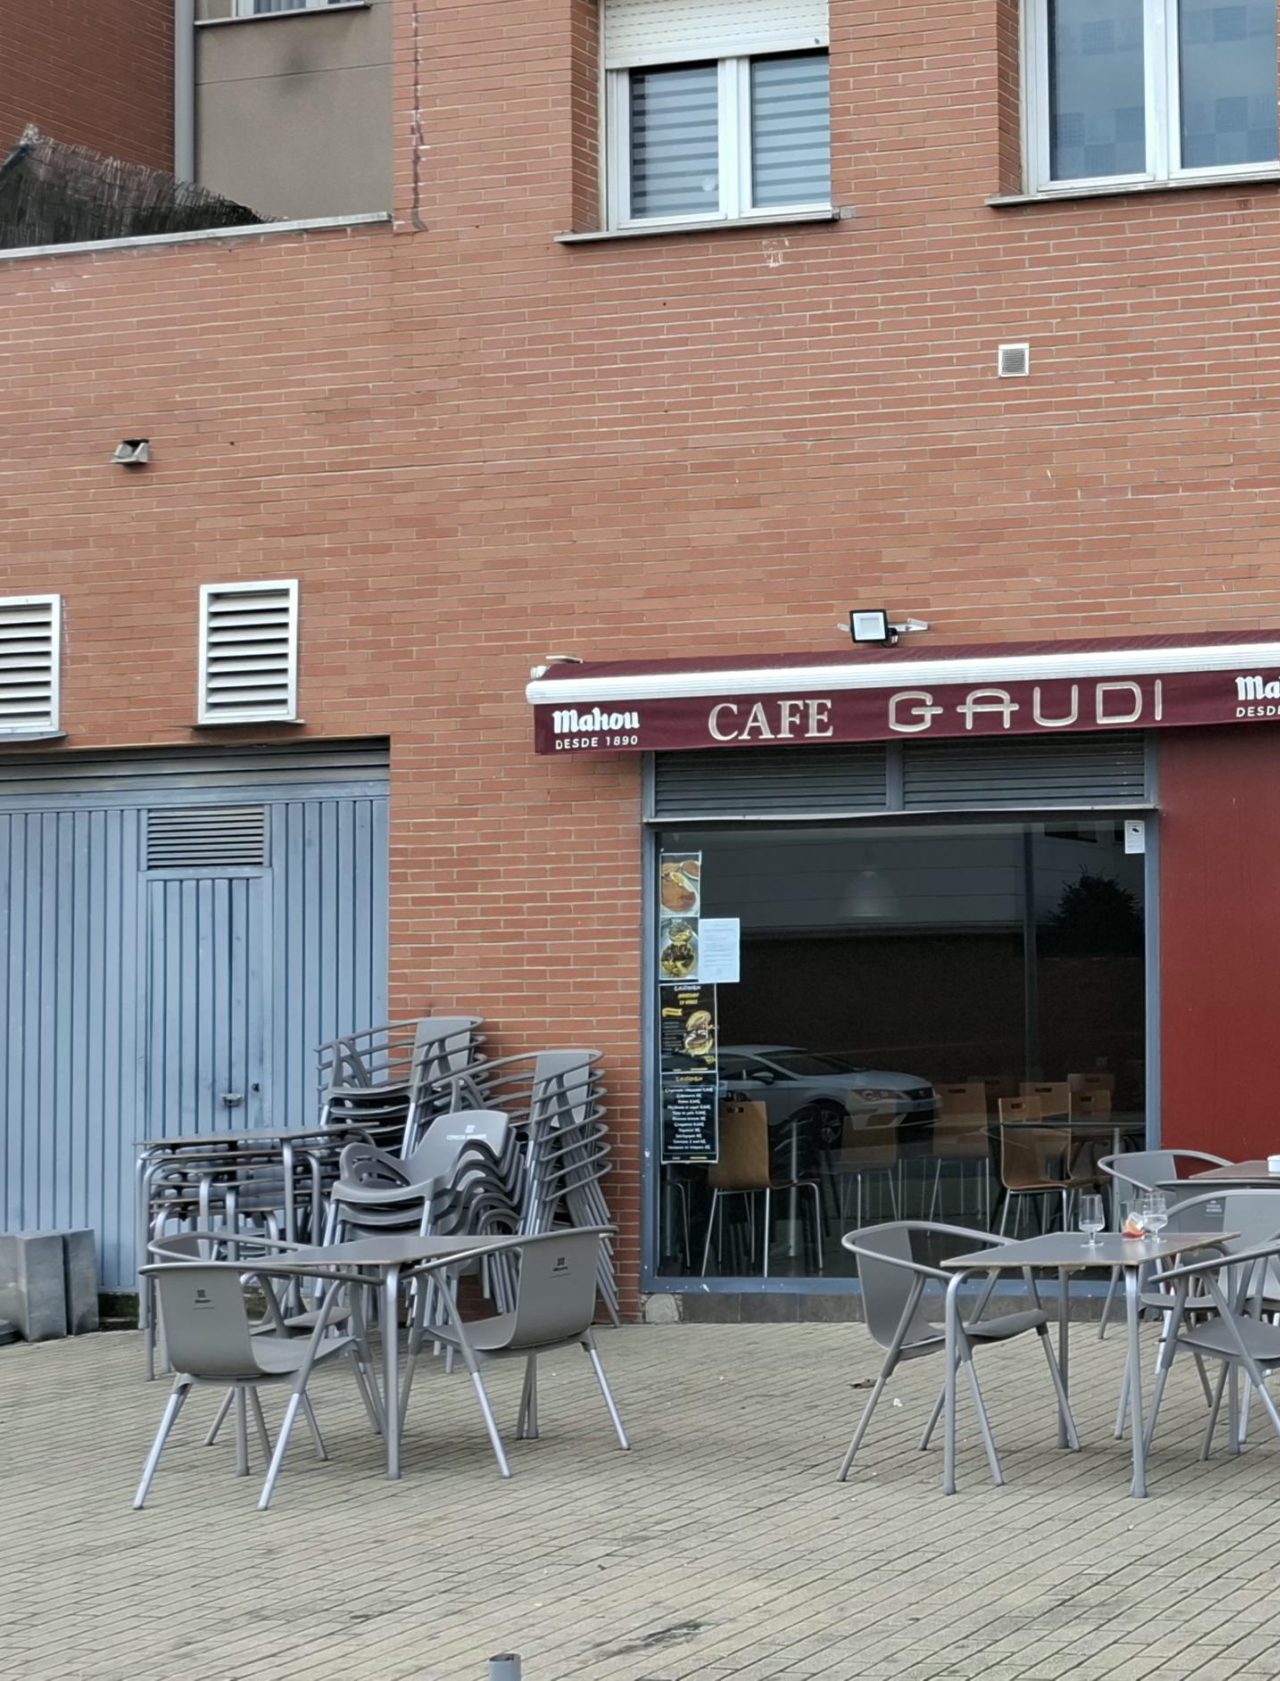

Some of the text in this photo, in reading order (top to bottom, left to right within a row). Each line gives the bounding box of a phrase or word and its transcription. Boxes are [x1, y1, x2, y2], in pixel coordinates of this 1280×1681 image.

[553, 707, 640, 733] Mahou
[707, 679, 1162, 741] CAFE GAUDI
[555, 735, 638, 750] DESDE 1890
